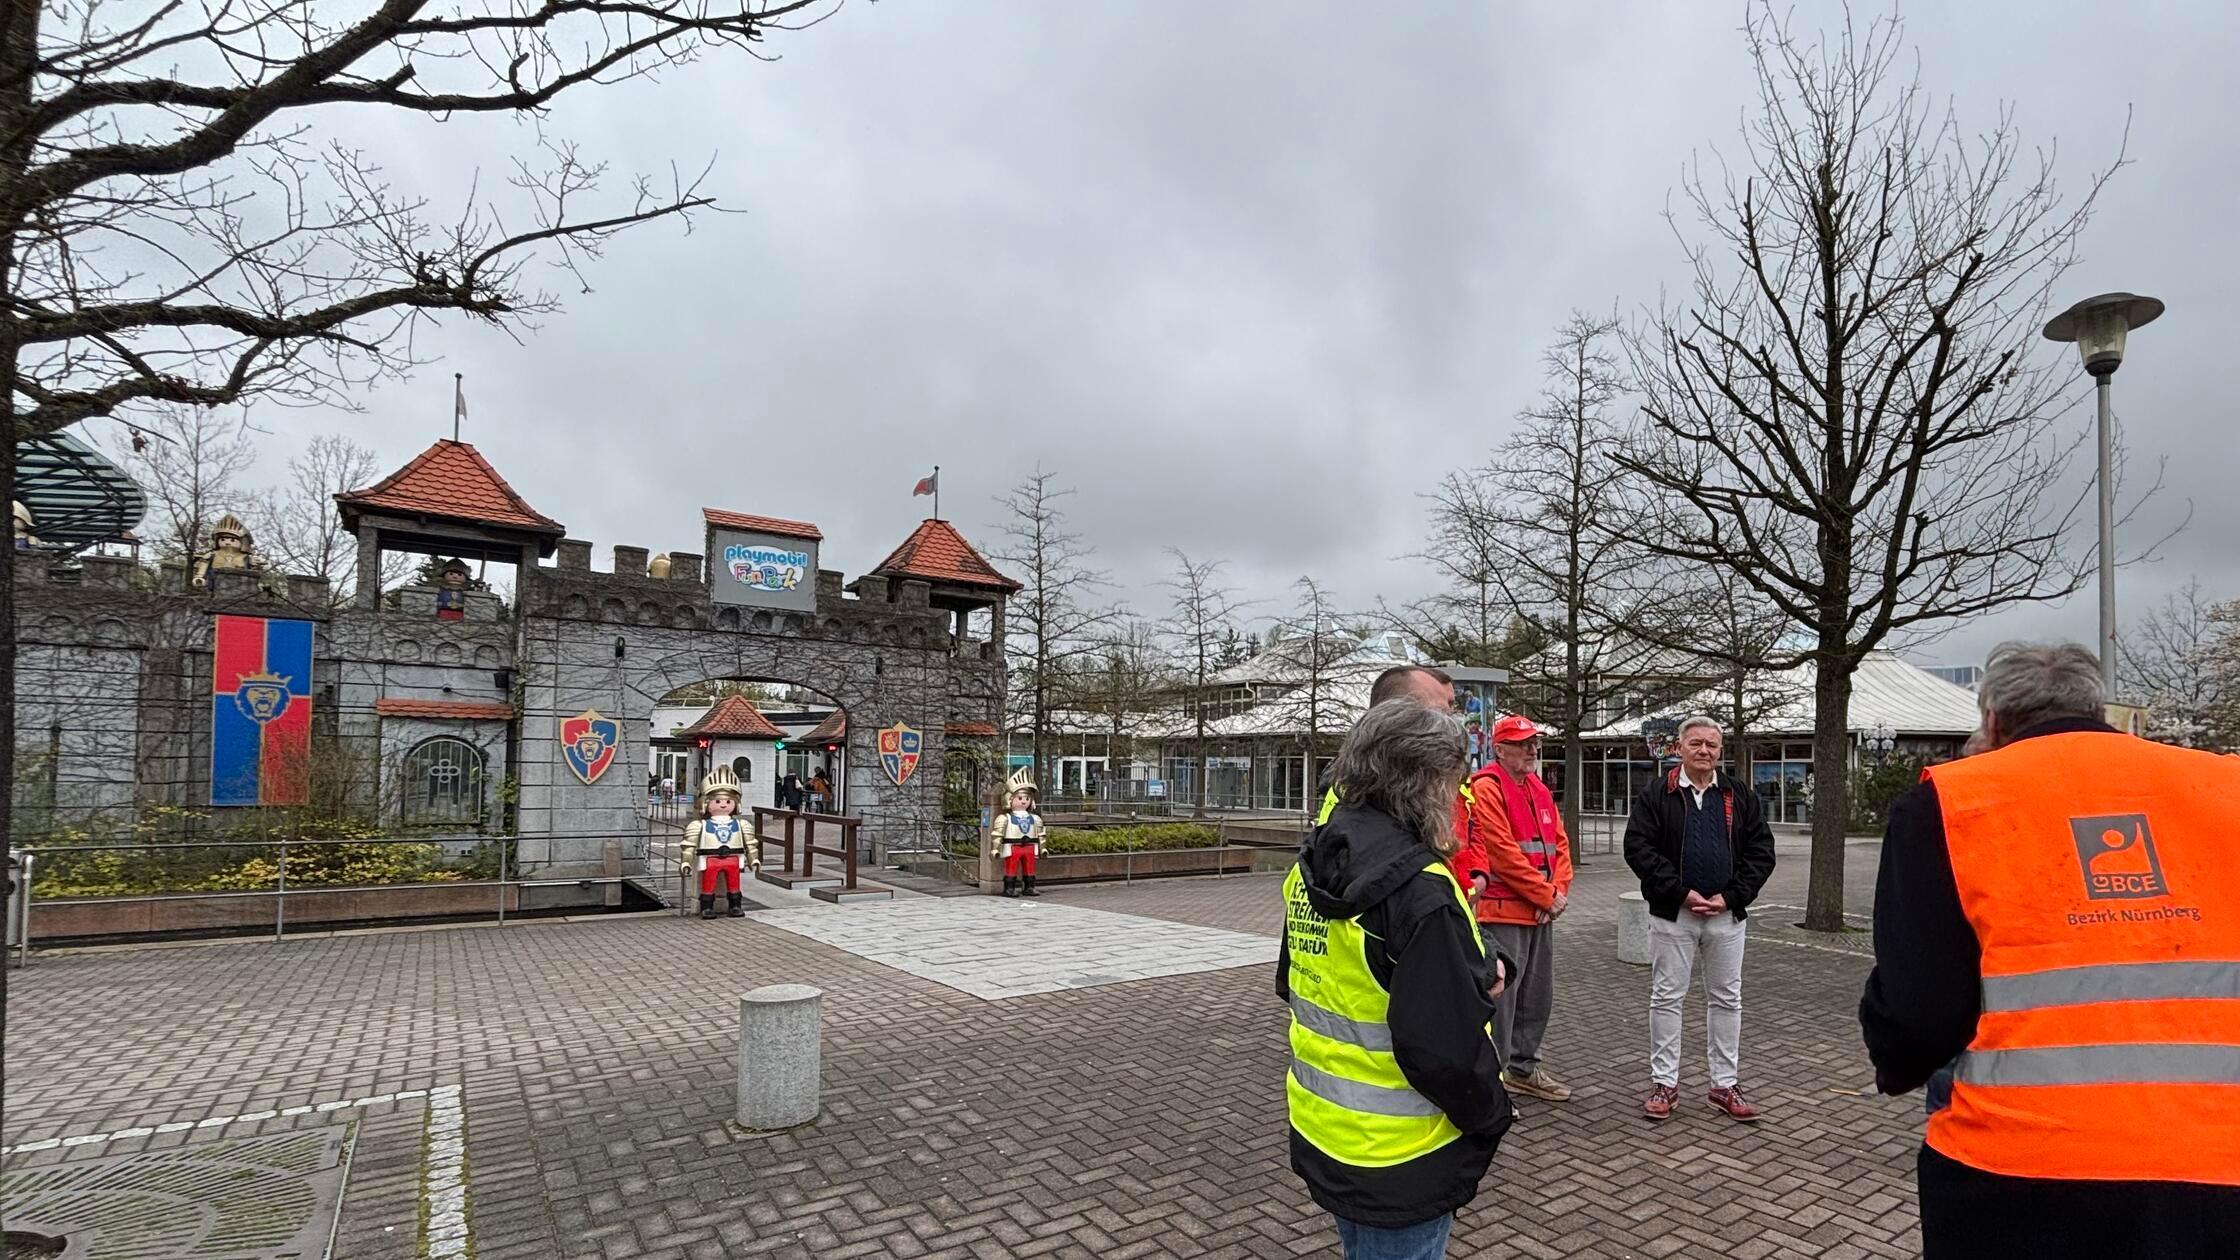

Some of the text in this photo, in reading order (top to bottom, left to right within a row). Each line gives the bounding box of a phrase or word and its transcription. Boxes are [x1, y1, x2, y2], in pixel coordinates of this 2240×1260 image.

[725, 545, 807, 567] playmobil
[2067, 906, 2201, 926] Bezirk Nürnberg
[1298, 936, 1329, 957] DAFÜR
